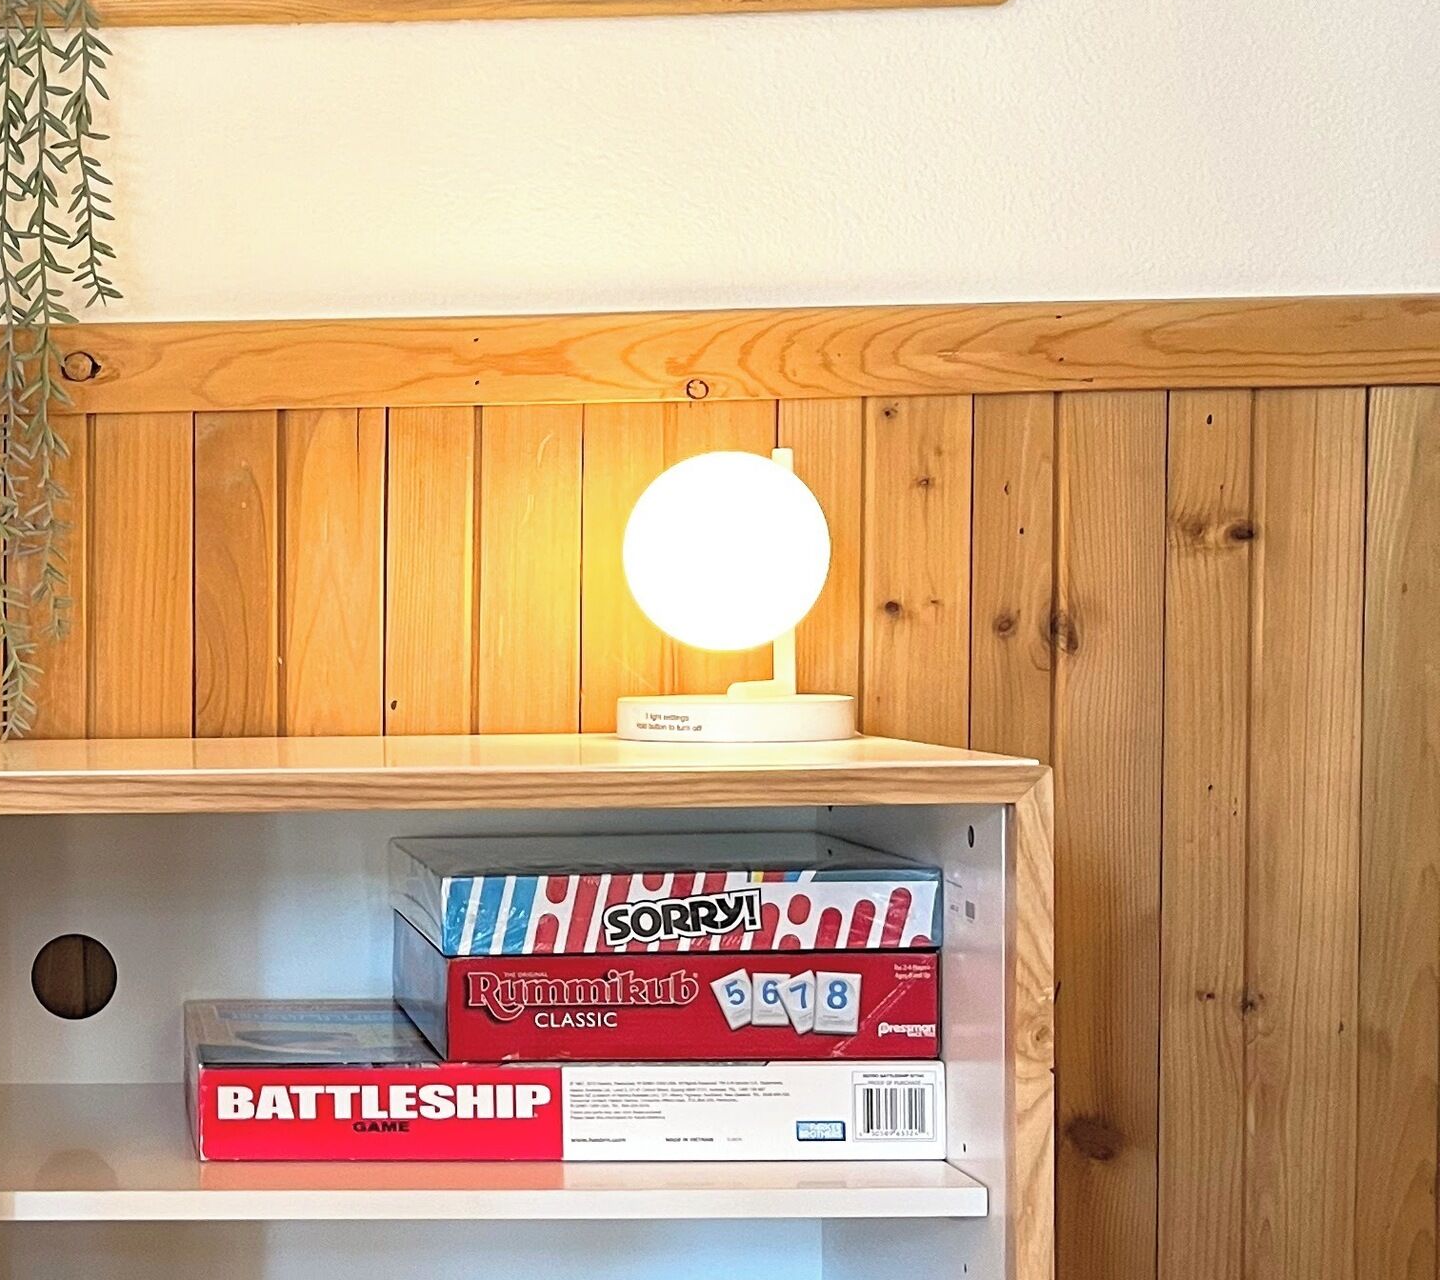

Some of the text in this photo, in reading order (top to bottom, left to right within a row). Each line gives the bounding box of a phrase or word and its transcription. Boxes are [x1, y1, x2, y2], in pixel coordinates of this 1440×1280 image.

[606, 892, 759, 942] SORRY!
[466, 969, 699, 1021] Rummikub
[724, 979, 849, 1010] 5 6 7 8
[534, 1011, 618, 1029] CLASSIC
[216, 1084, 552, 1121] BATTLESHIP
[353, 1121, 410, 1133] GAME
